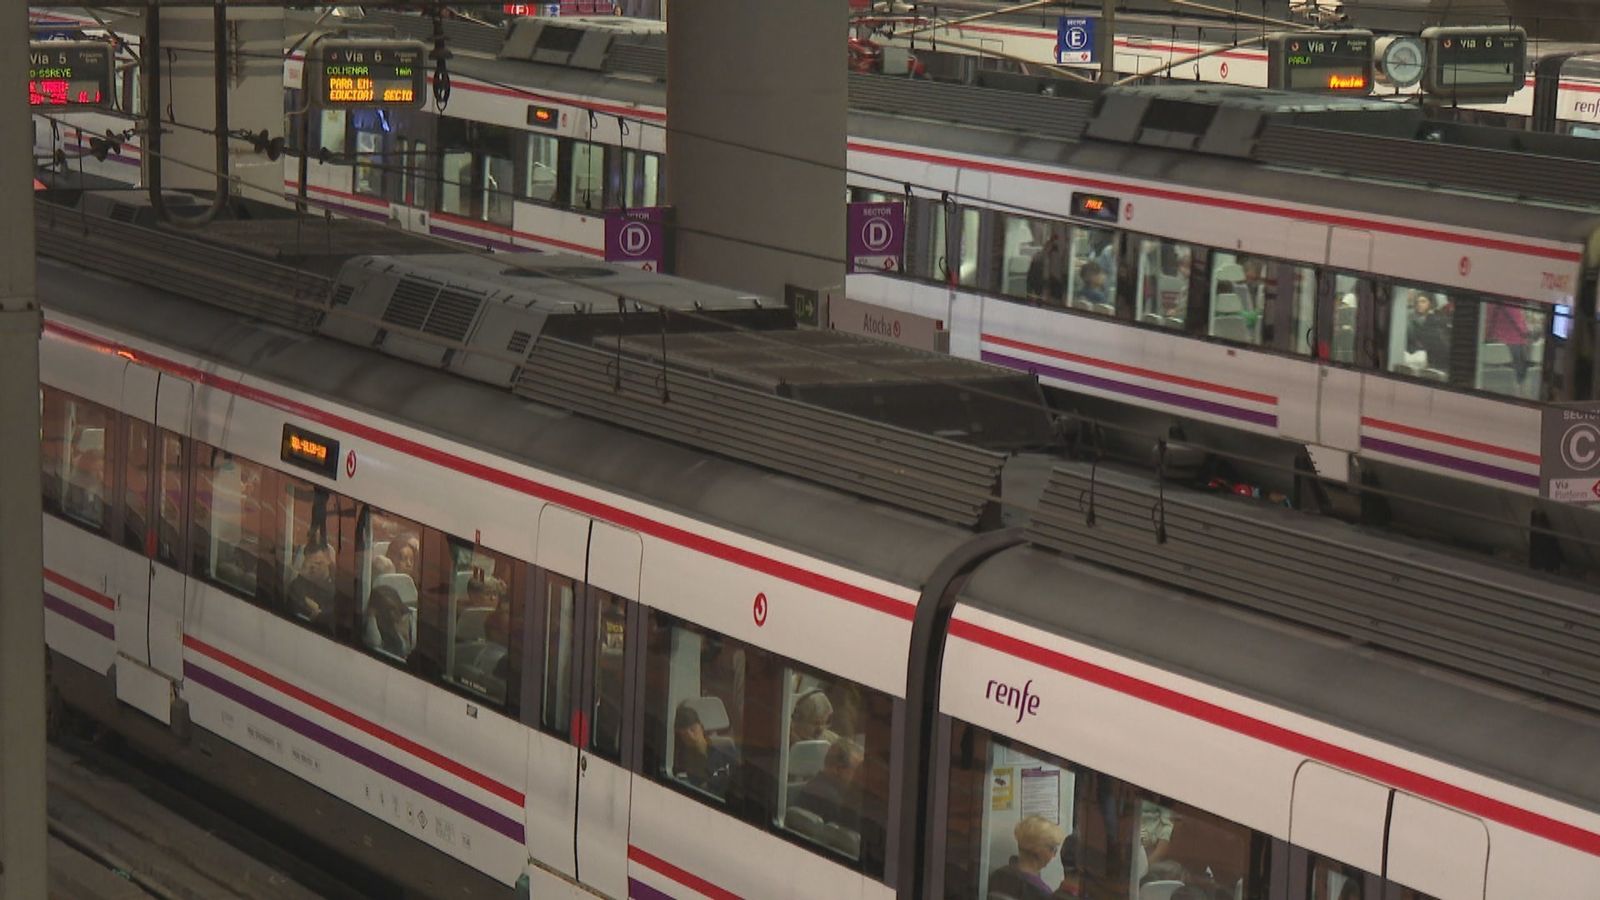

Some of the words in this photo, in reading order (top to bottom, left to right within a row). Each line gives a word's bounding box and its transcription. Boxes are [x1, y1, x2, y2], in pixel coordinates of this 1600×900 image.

[1071, 31, 1082, 46] E
[1330, 41, 1338, 53] 7
[58, 52, 67, 64] 5
[374, 50, 382, 62] 6
[326, 66, 369, 76] COLMENAR
[329, 78, 353, 90] PARA
[1574, 98, 1600, 119] renf
[863, 207, 892, 217] SECTOR
[626, 227, 646, 251] D
[869, 223, 888, 246] D
[863, 313, 892, 337] Atocha
[1569, 430, 1597, 464] C
[985, 679, 1041, 724] renfe
